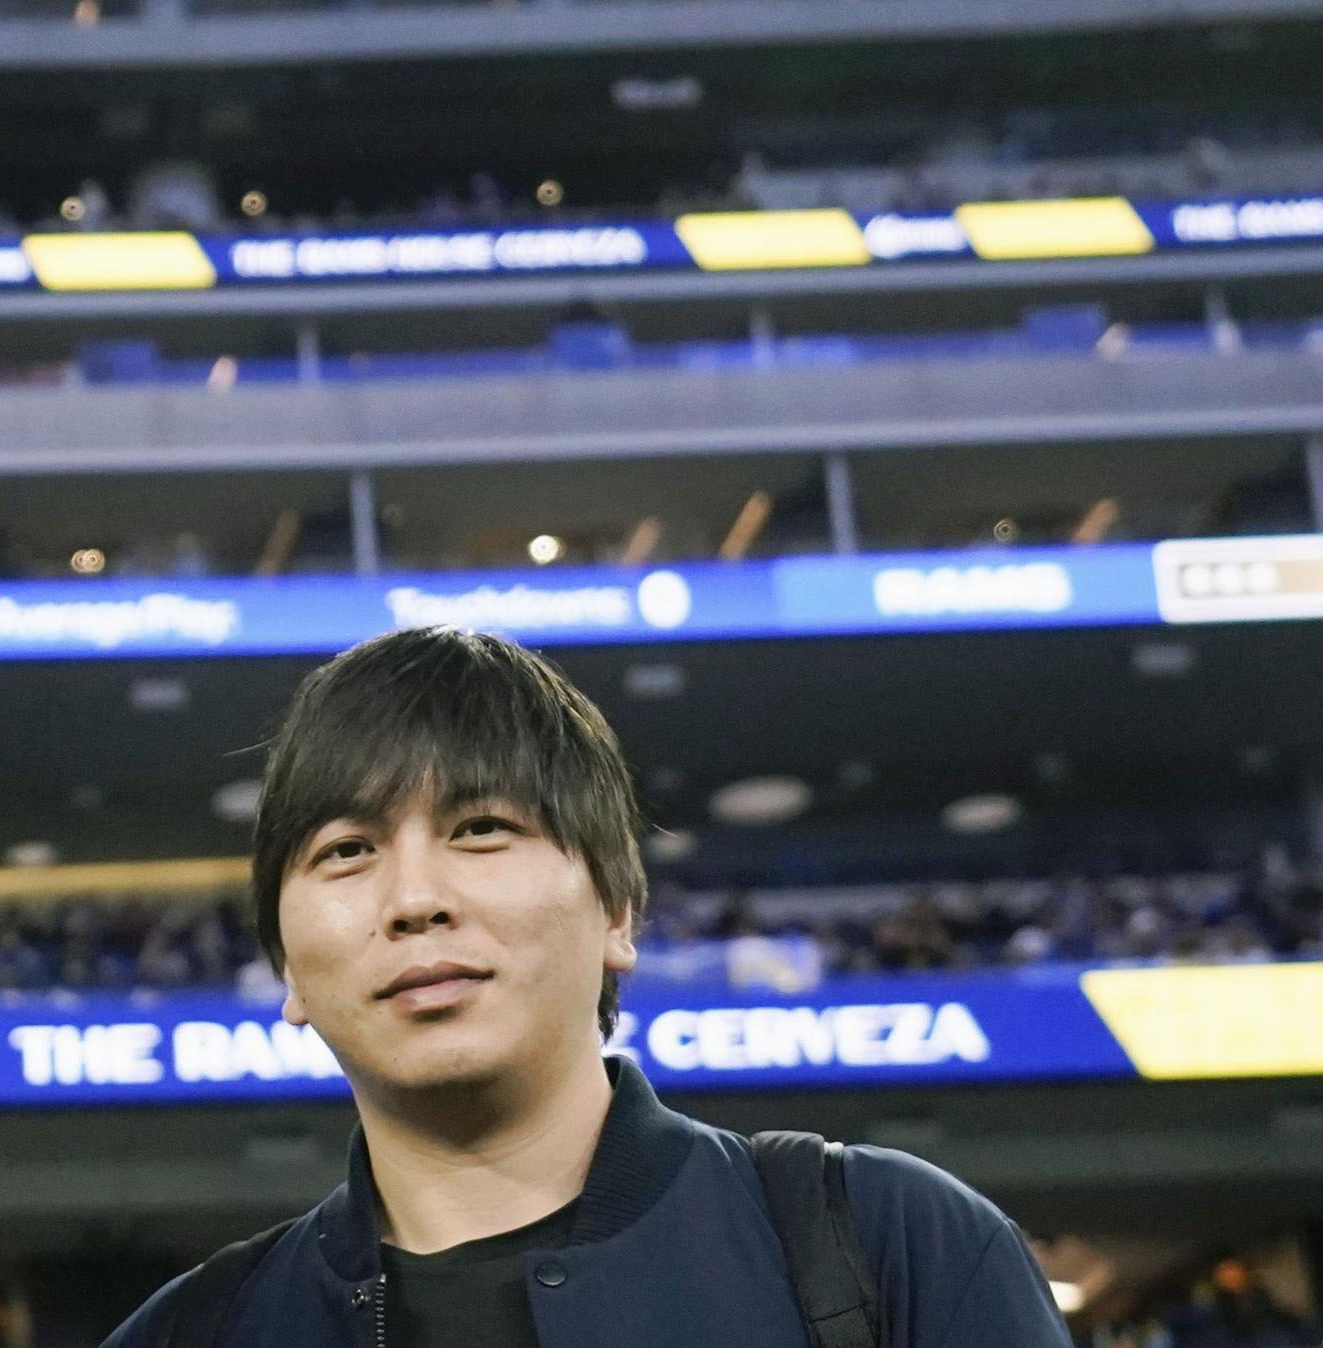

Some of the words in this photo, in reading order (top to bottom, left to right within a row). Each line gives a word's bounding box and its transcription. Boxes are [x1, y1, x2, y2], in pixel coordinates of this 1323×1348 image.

[8, 1022, 163, 1086] THE
[173, 1020, 346, 1082] RAM
[648, 1003, 990, 1070] CERVEZA
